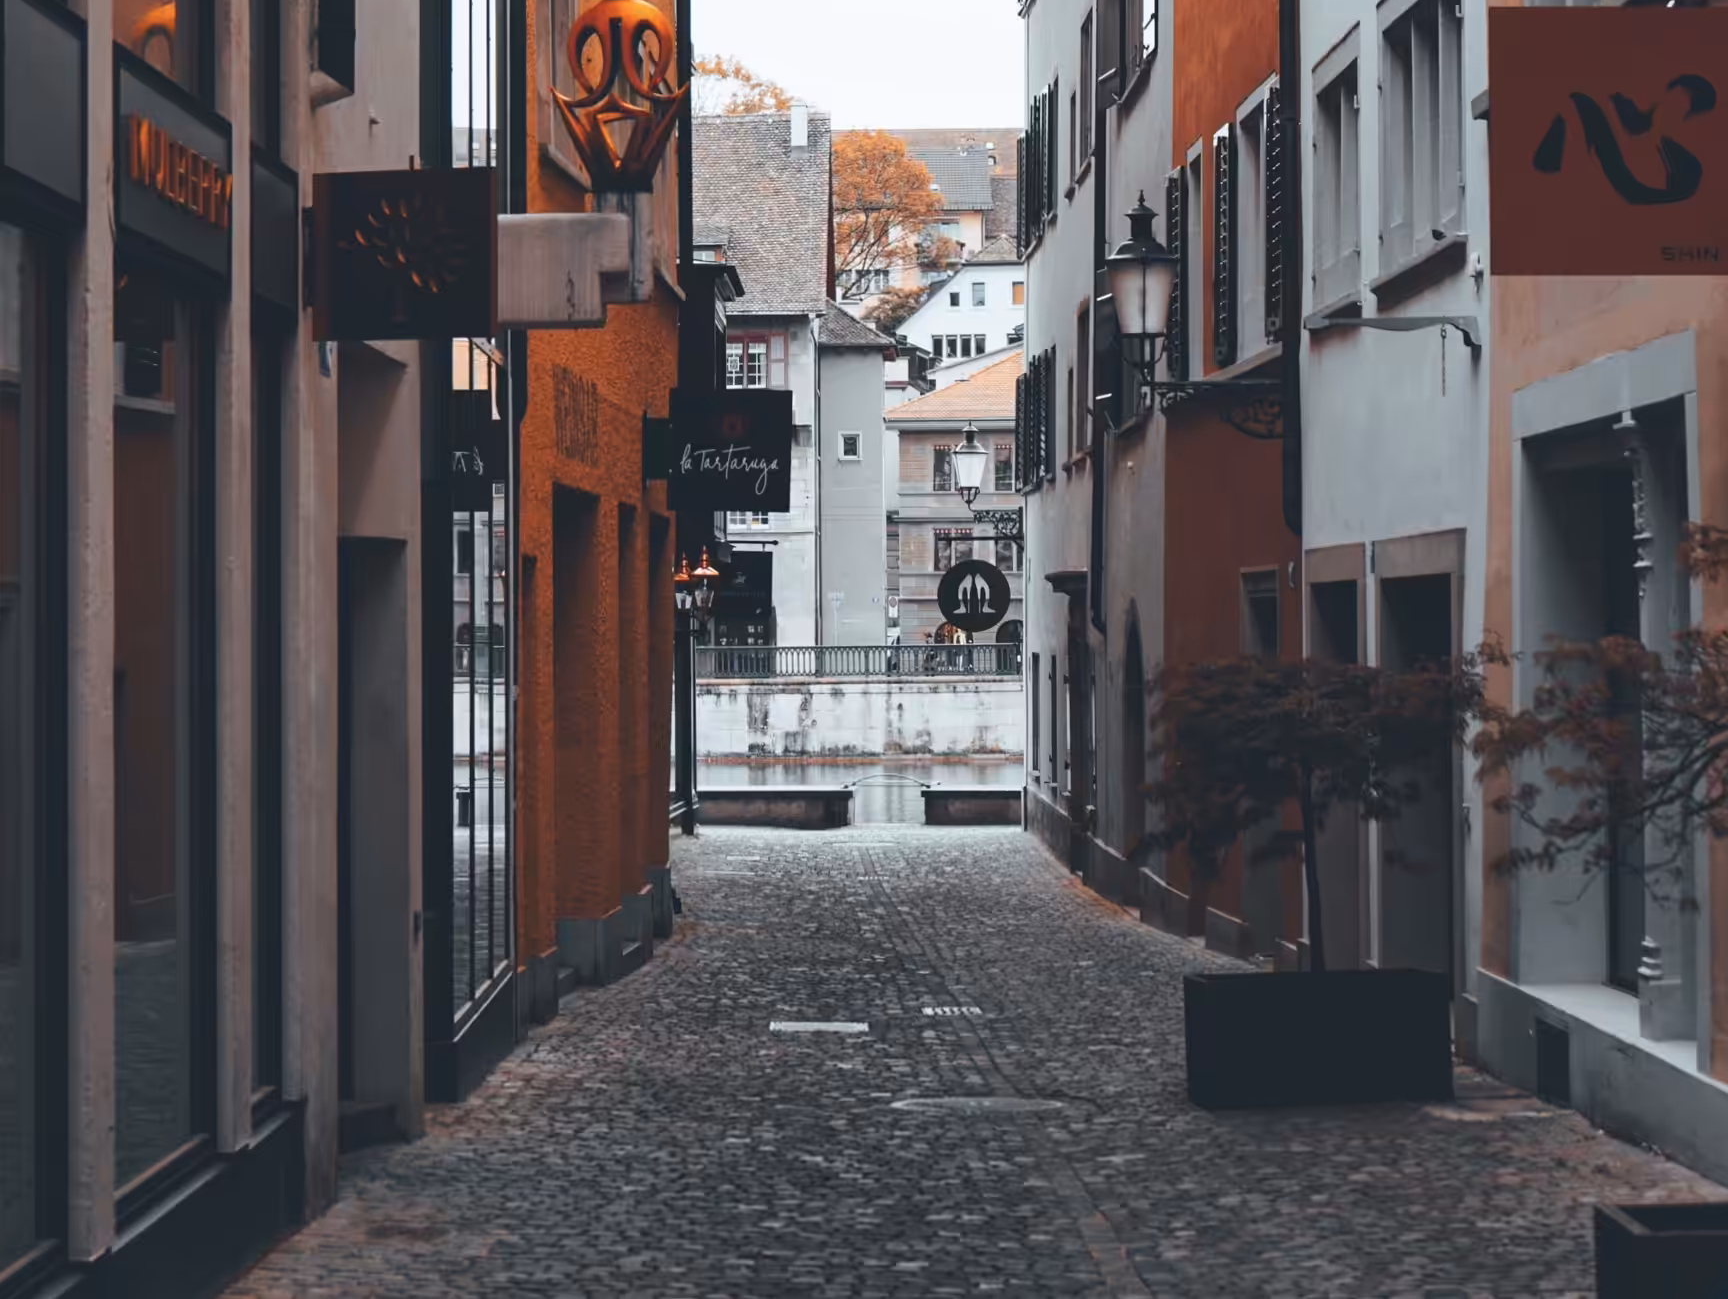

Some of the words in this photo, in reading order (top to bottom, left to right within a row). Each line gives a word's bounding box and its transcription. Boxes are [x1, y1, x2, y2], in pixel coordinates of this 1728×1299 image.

[1532, 74, 1717, 205] 心
[1661, 246, 1719, 261] SHIN
[694, 443, 779, 495] Tartaruga
